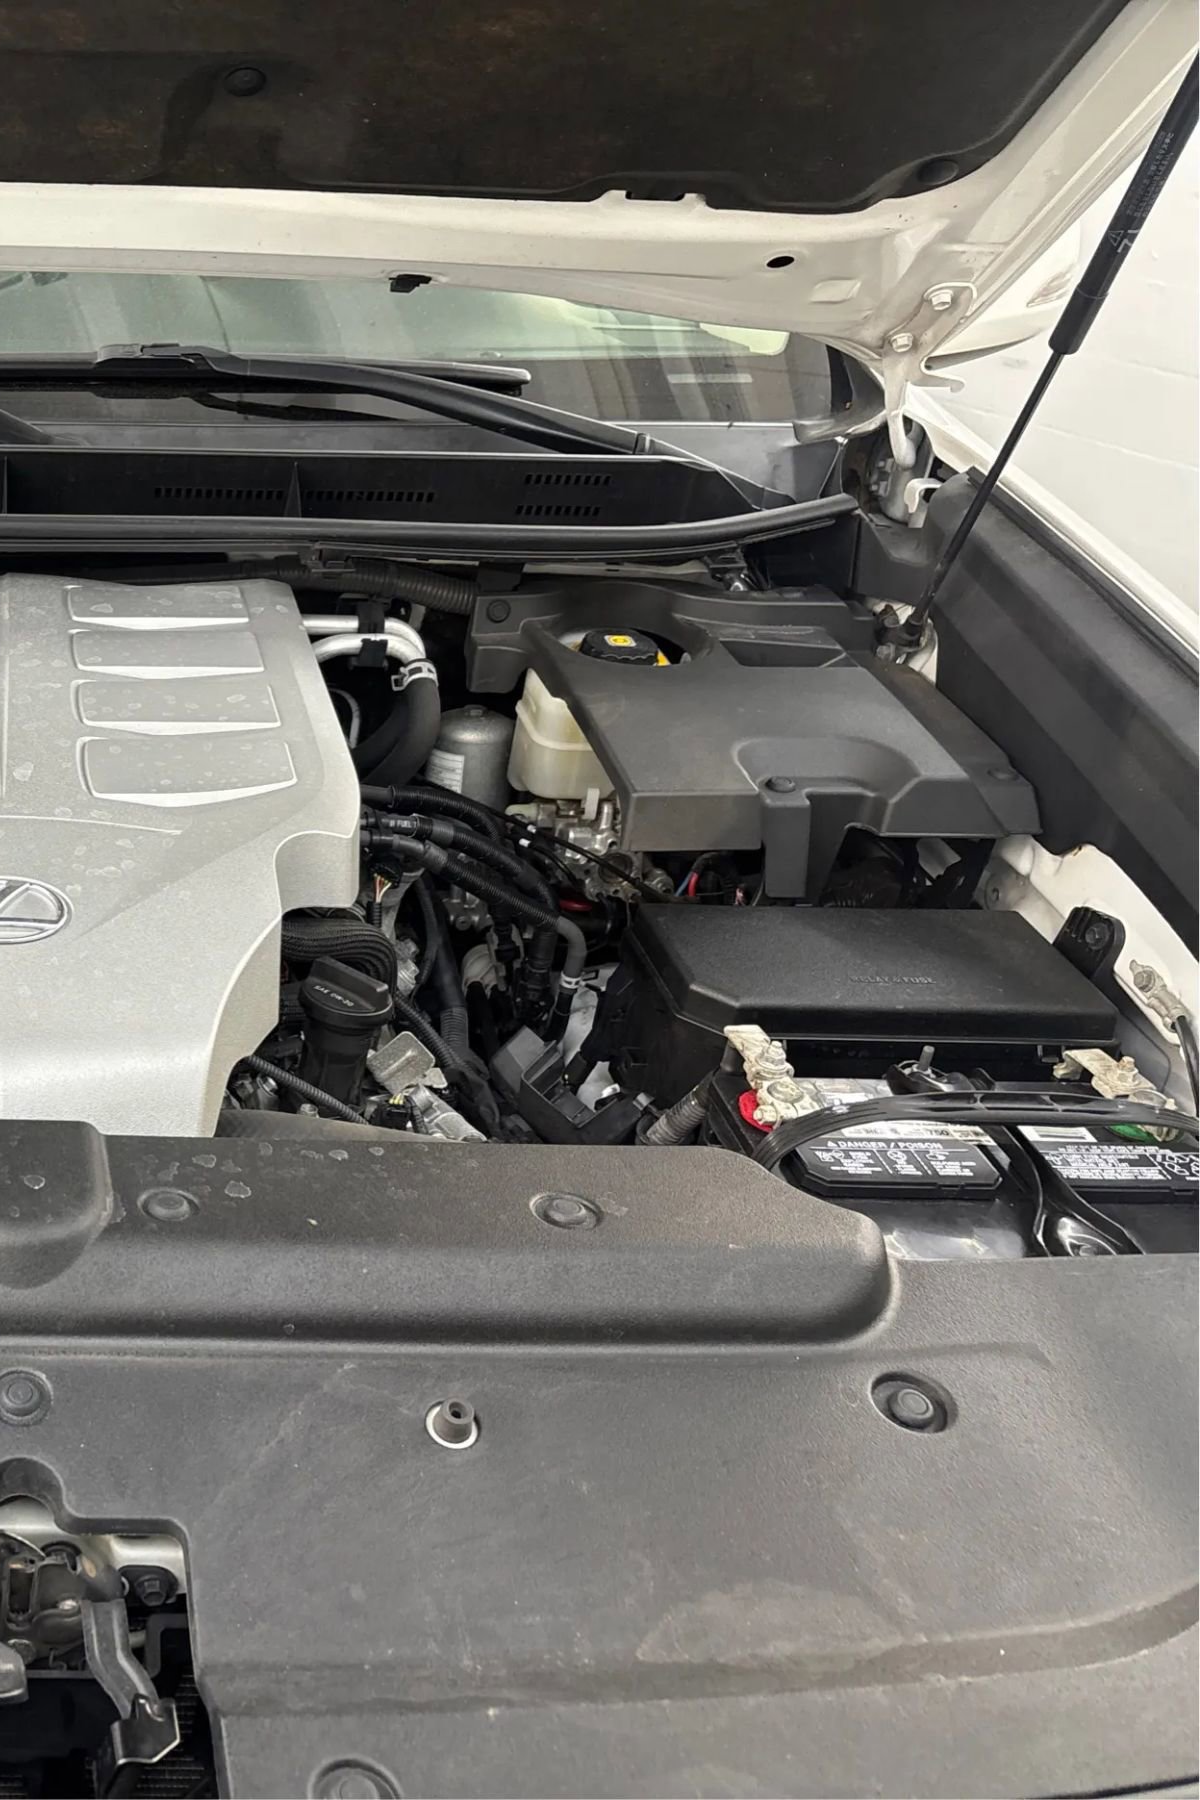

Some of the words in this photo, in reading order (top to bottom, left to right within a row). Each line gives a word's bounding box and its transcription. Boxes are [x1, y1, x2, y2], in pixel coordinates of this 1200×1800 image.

[901, 975, 937, 985] FUSE
[312, 984, 330, 995] SAE
[838, 1140, 887, 1150] DANGER
[898, 1140, 944, 1151] POISON
